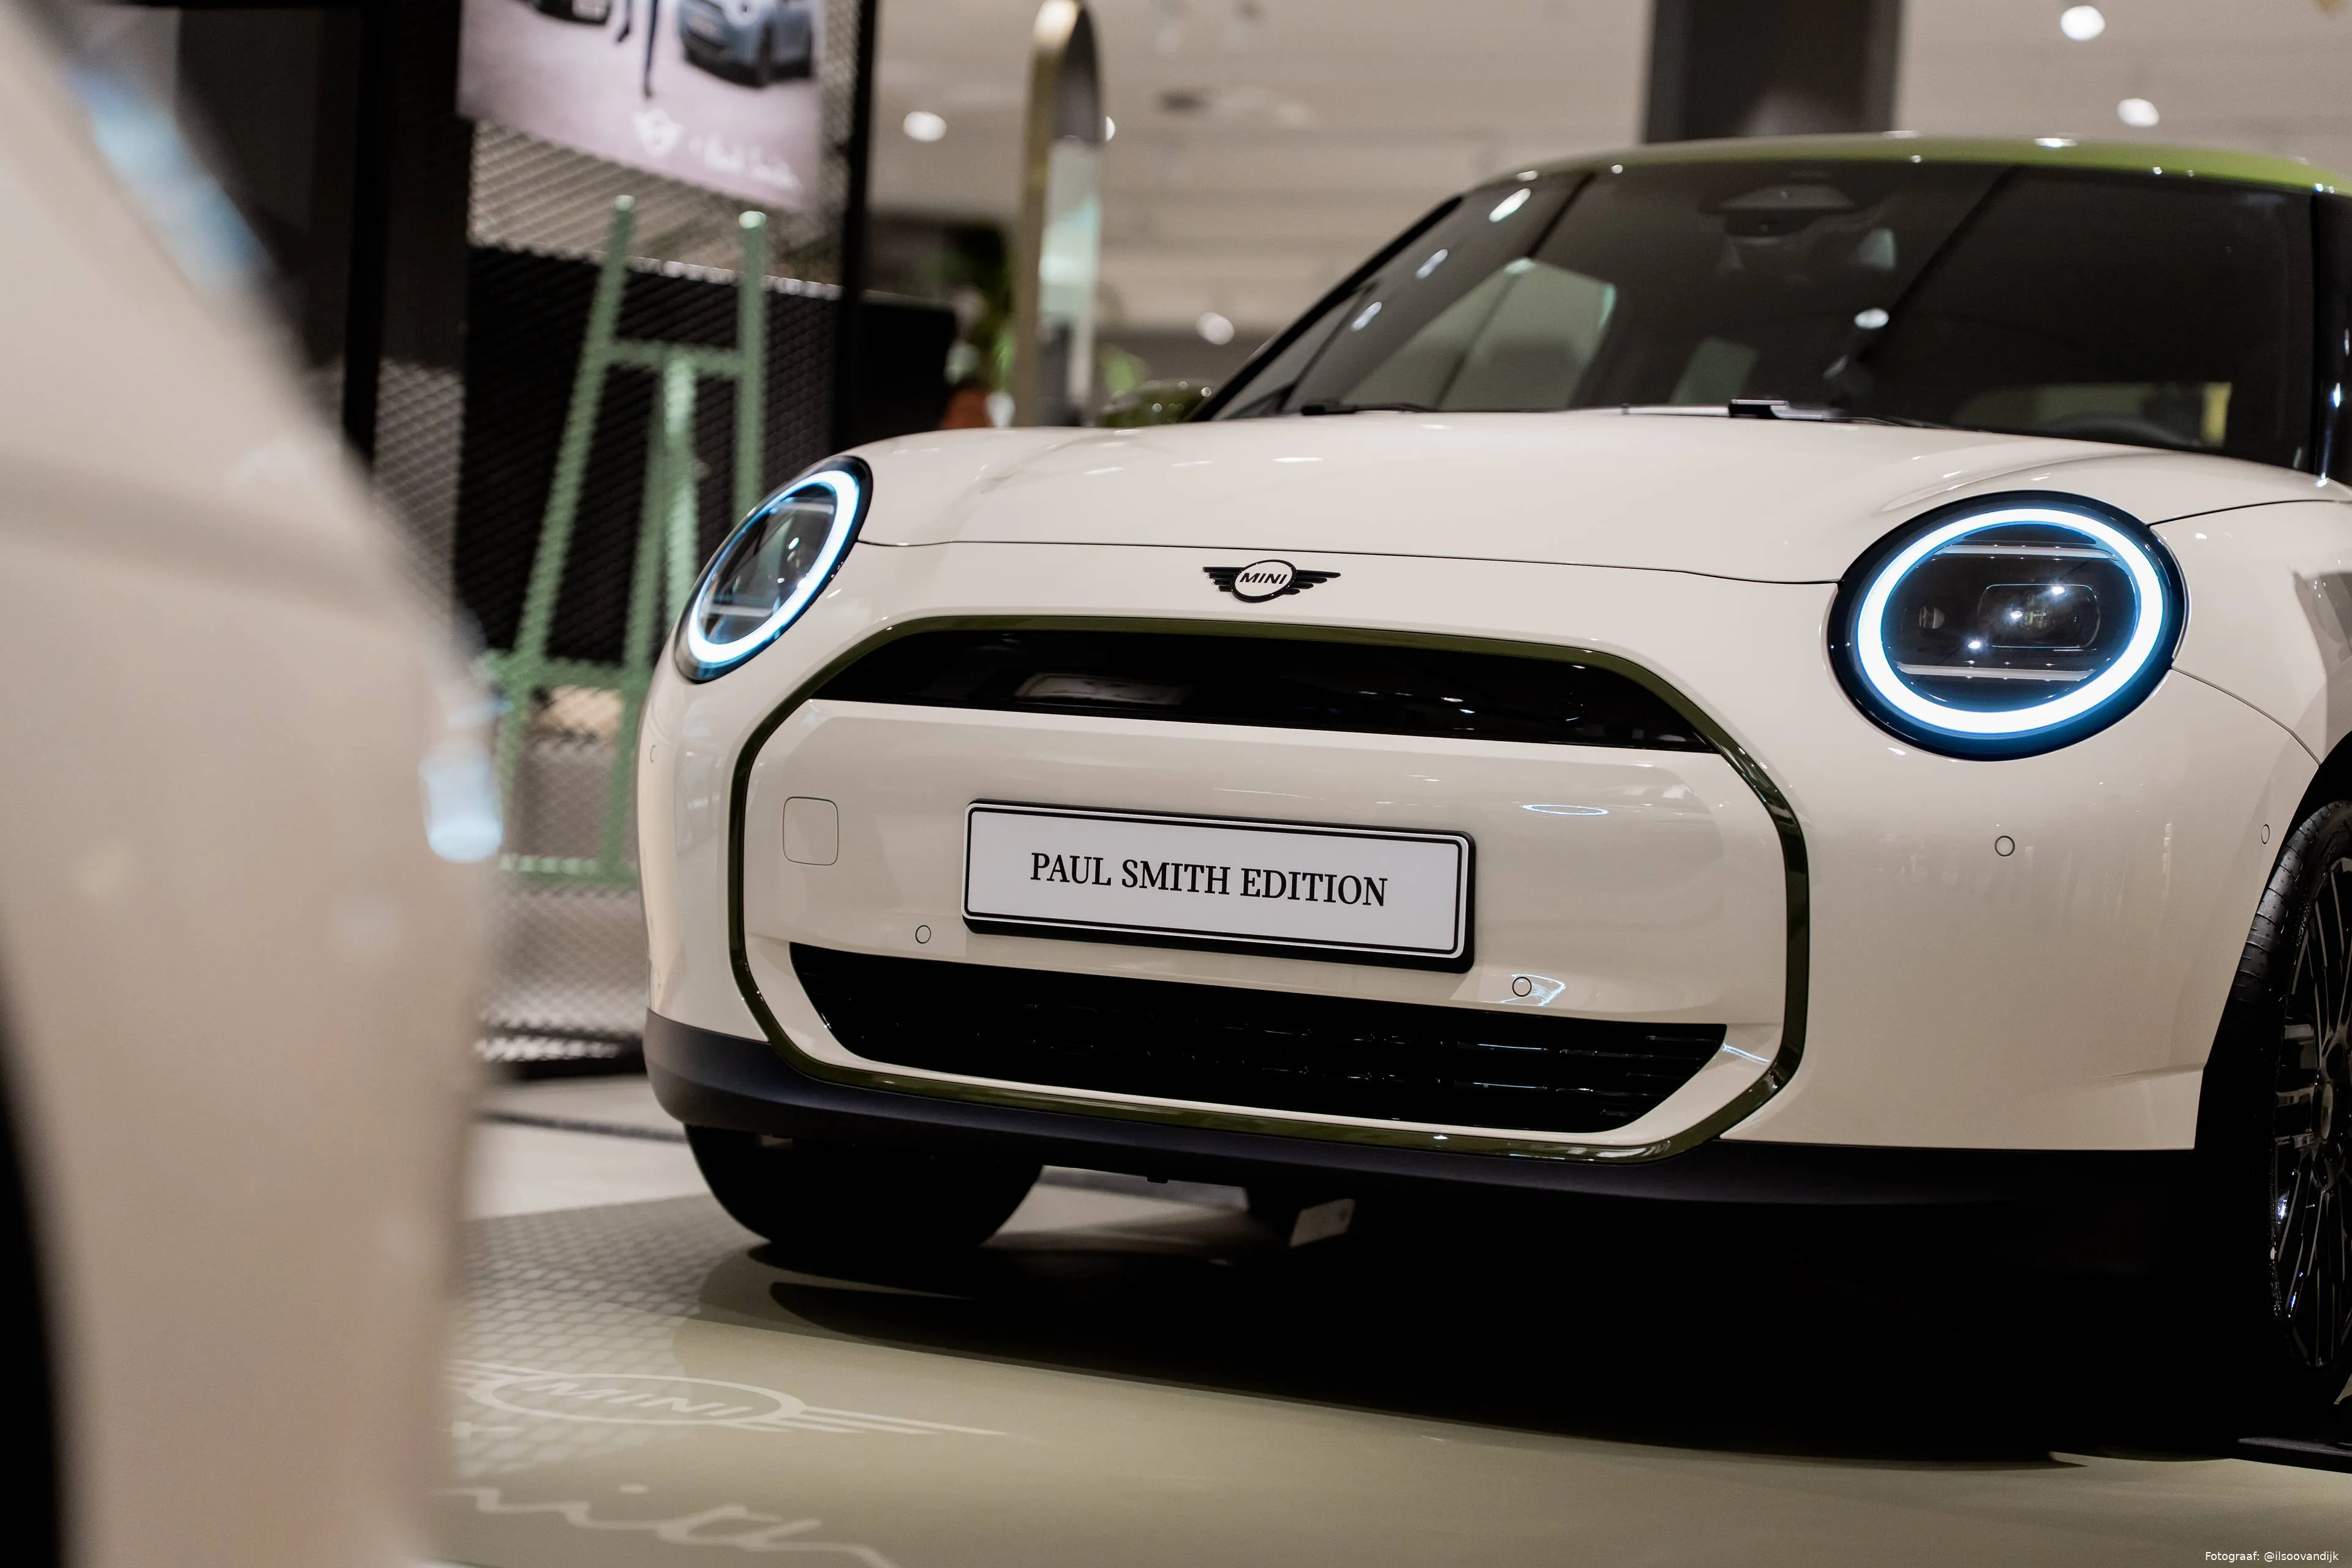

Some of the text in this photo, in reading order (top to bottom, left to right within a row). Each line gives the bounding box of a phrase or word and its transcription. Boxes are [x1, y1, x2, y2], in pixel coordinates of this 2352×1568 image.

[1239, 572, 1288, 584] MINI
[1030, 852, 1388, 907] PAUL SMITH EDITION
[522, 1382, 753, 1417] MINI
